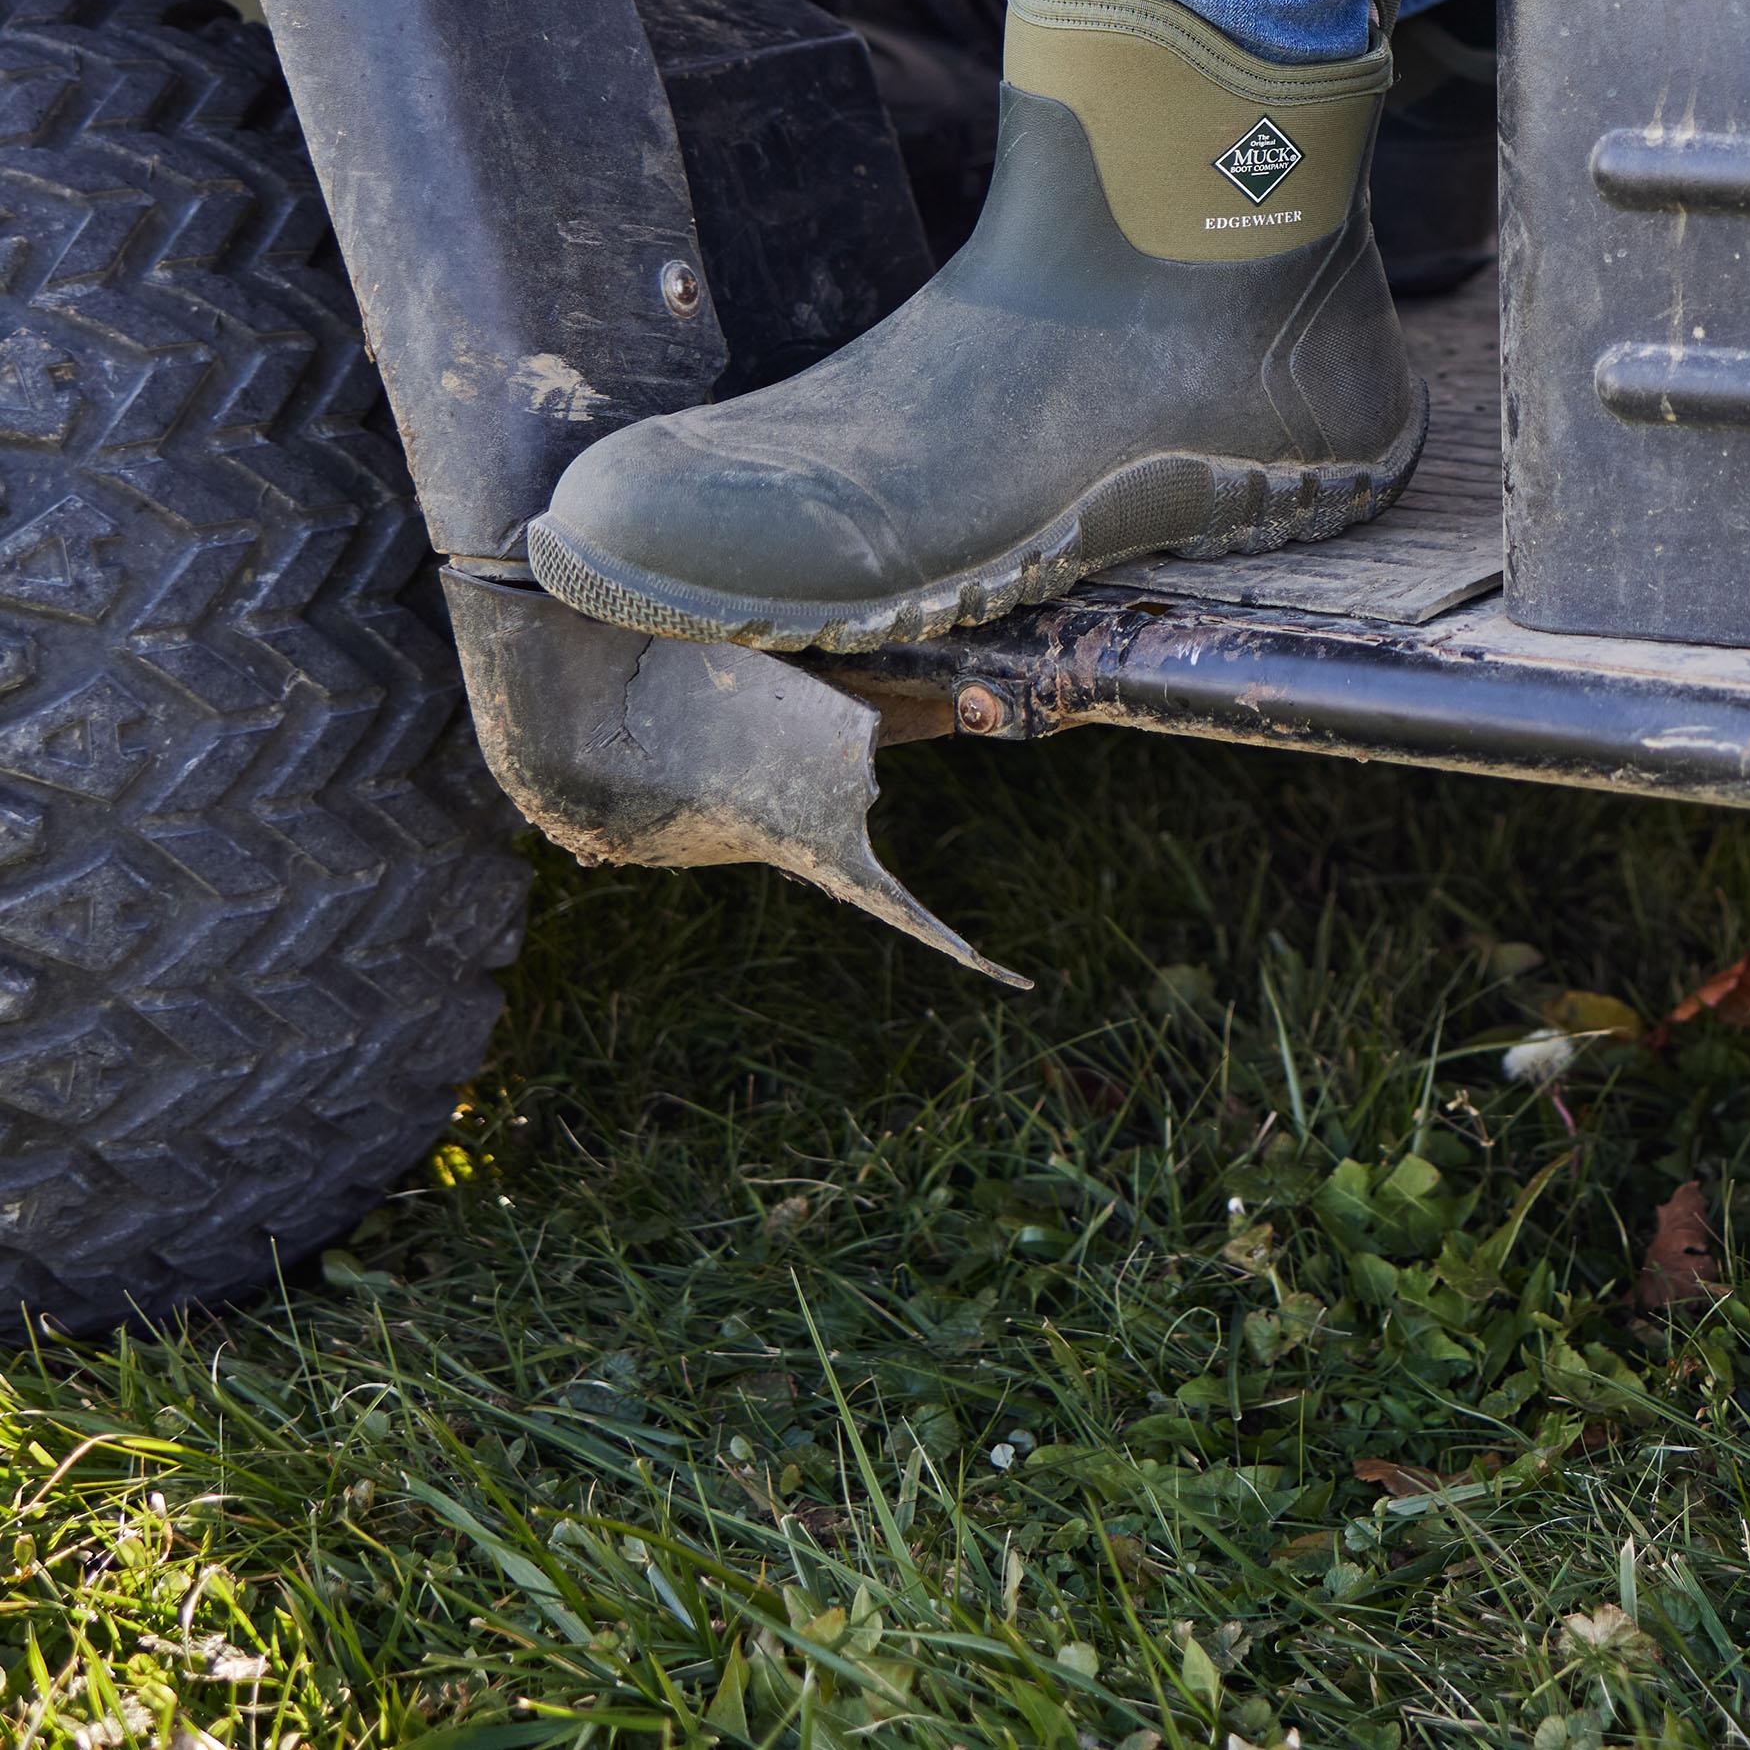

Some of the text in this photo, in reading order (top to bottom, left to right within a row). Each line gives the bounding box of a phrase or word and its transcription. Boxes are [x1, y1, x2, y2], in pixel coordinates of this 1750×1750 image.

[1250, 139, 1276, 148] Original
[1230, 162, 1289, 173] BOOT COMPANY
[1205, 210, 1302, 230] EDGEWATER
